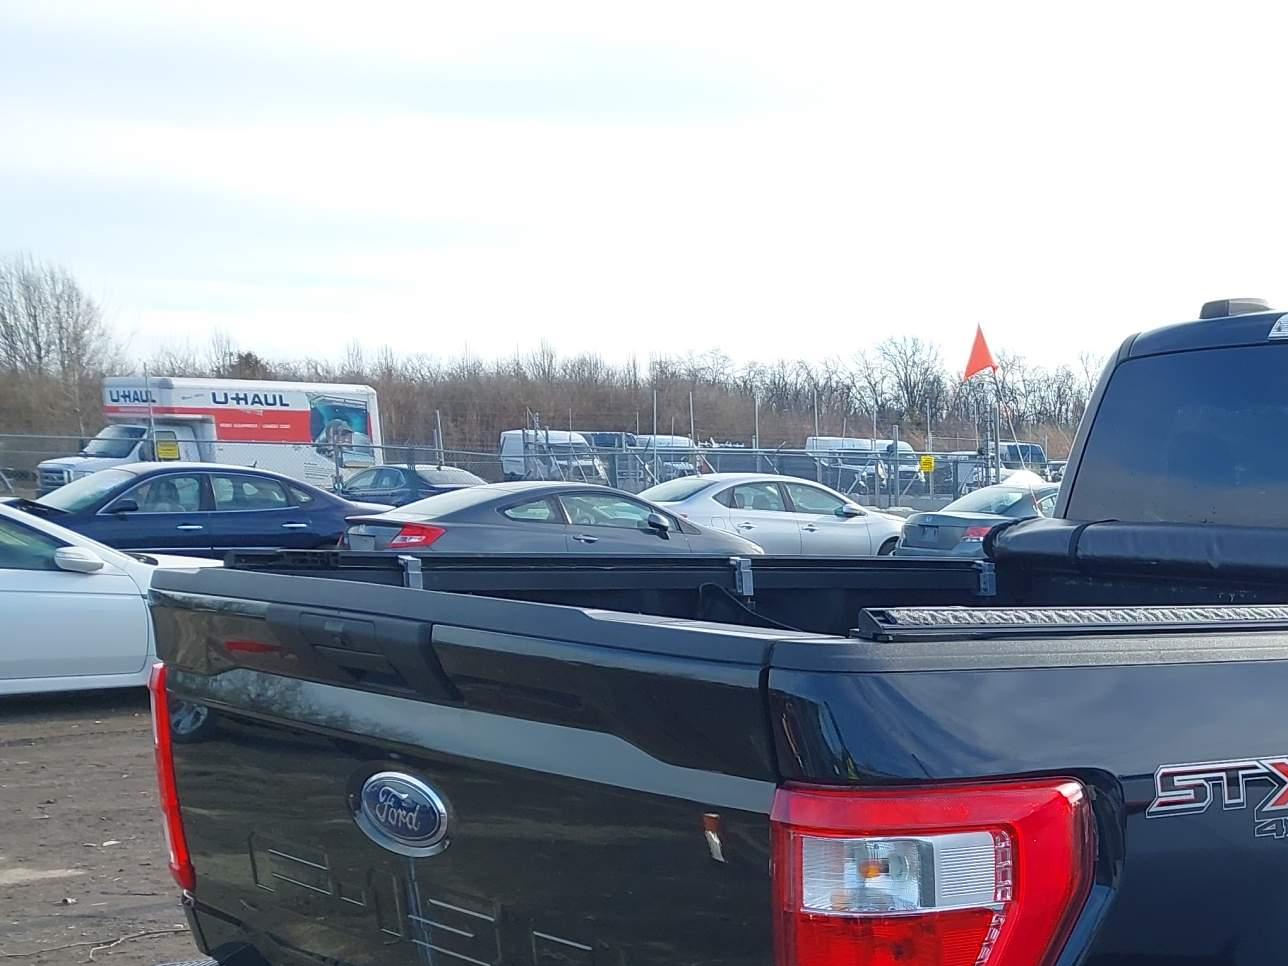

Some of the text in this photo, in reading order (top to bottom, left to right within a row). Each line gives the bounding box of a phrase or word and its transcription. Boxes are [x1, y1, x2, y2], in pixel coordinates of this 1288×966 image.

[109, 390, 157, 403] U-HAUL
[211, 391, 290, 407] U-HAUL
[375, 786, 421, 832] Ford
